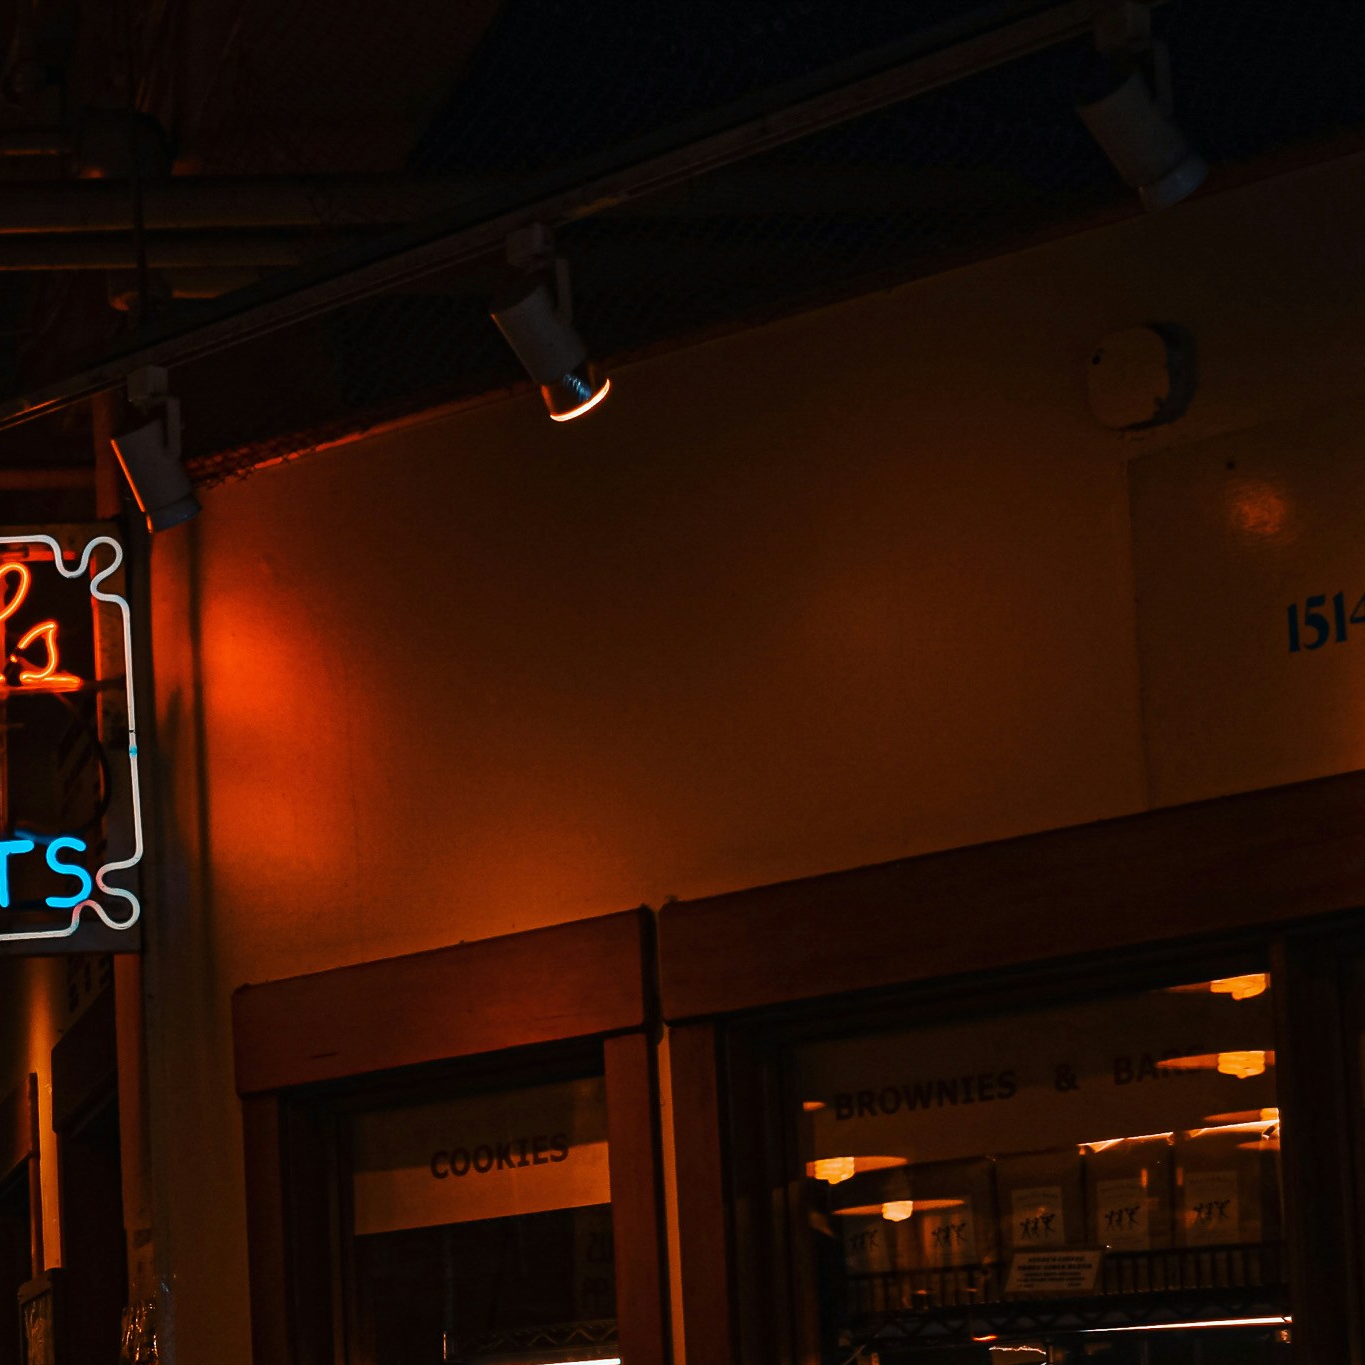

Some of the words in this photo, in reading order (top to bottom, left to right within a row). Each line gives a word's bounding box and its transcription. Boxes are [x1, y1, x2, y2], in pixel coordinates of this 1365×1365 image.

[834, 1070, 1017, 1122] BROWNIES
[1054, 1063, 1080, 1093] &
[430, 1132, 569, 1180] COOKIES
